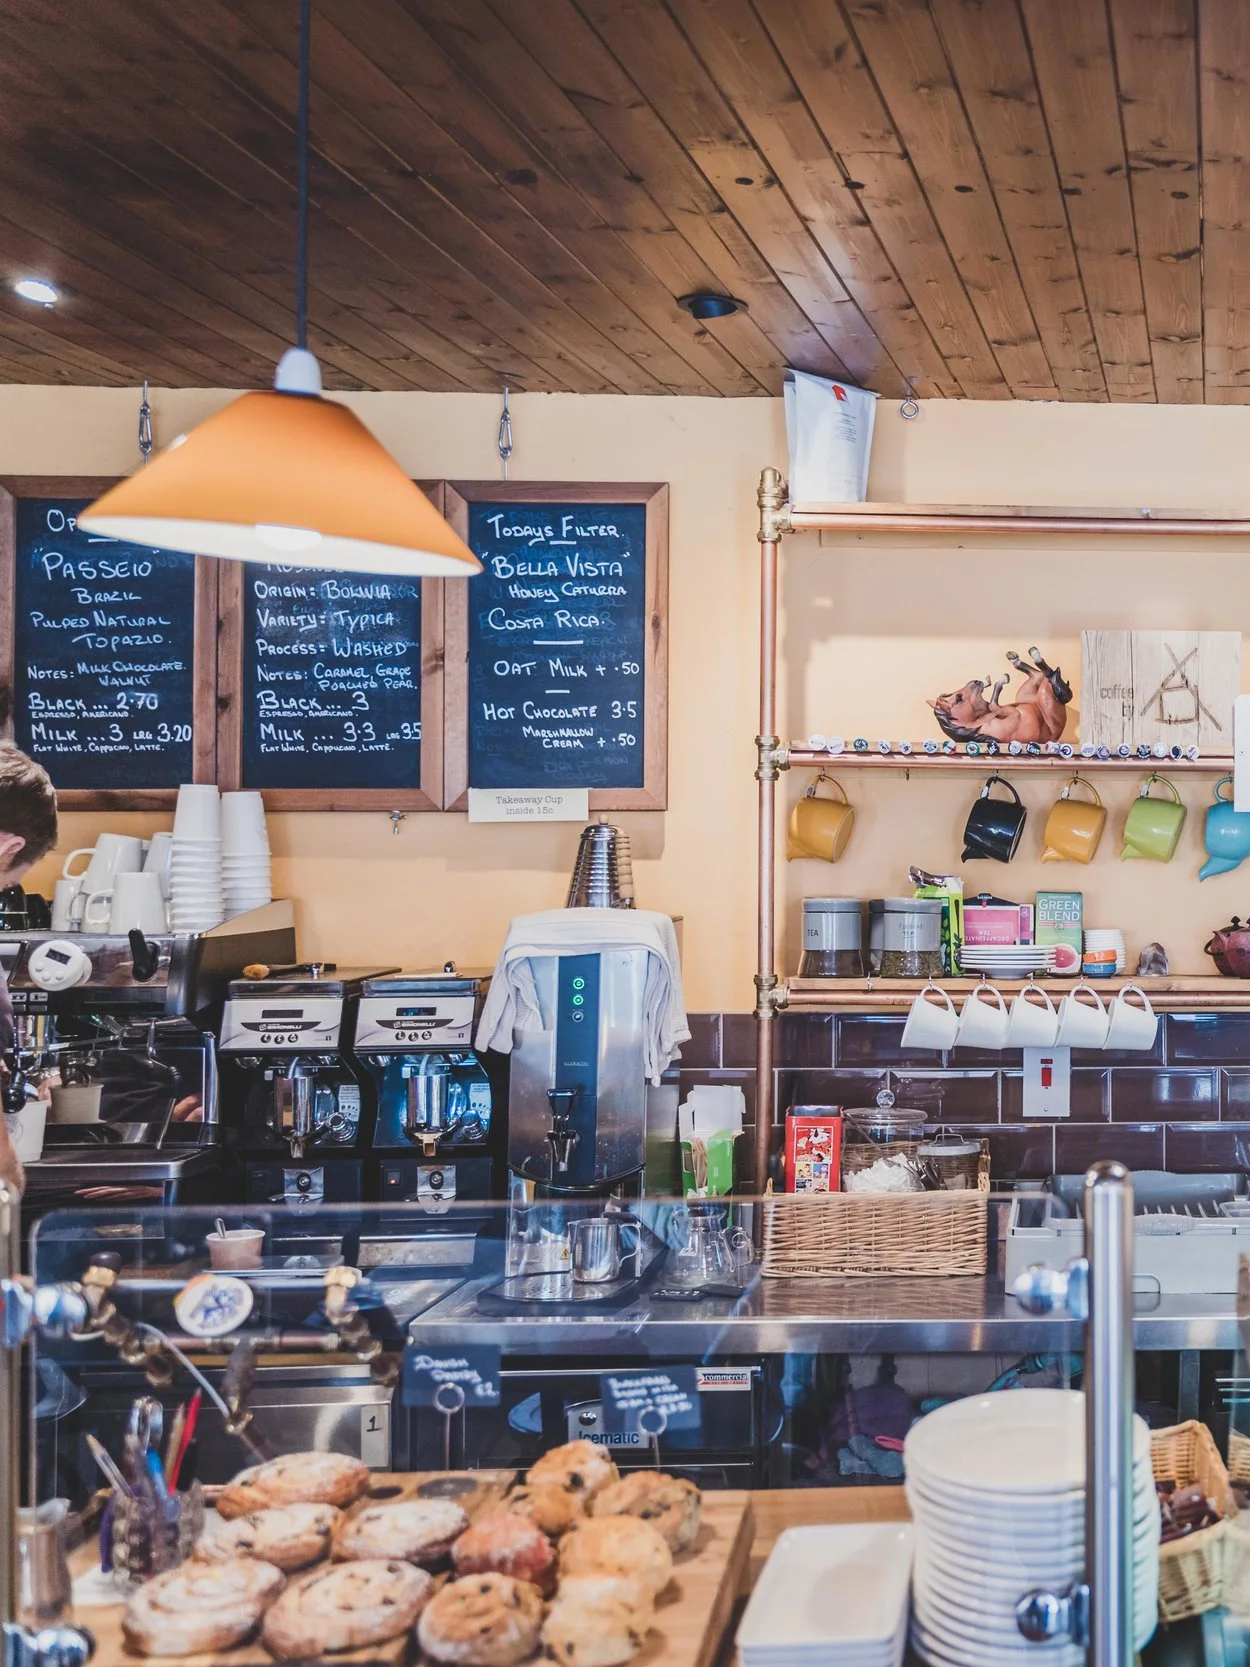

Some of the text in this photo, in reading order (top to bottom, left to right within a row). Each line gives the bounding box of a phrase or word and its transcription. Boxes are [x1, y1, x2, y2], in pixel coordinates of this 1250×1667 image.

[487, 514, 554, 546] TODAYS
[71, 588, 142, 604] BRAZIL
[509, 584, 558, 602] HONEY
[30, 610, 172, 629] PULPED NATURAL
[334, 609, 394, 633] TYPICA
[488, 607, 544, 631] COSTA
[333, 638, 407, 658] WASHED
[77, 662, 112, 675] MILK
[376, 663, 411, 677] GRAPE
[494, 661, 537, 676] OAT
[549, 658, 588, 678] MILK
[98, 674, 152, 687] WALNUT
[318, 679, 378, 691] POACHED
[1100, 684, 1133, 699] coffee
[28, 692, 87, 710] BLACK
[257, 690, 322, 710] BLACK
[352, 691, 369, 710] 3
[482, 700, 637, 720] HOT CHOCOLATE 3.5
[1122, 701, 1134, 720] by
[31, 722, 78, 741] MILK
[109, 724, 124, 742] 3
[133, 731, 153, 740] LRG
[157, 723, 192, 742] 3.20
[260, 723, 304, 741] MILK
[343, 722, 376, 742] 3.3
[522, 725, 594, 738] MARSHMALLOW
[261, 744, 280, 752] FLAT
[542, 739, 584, 749] CREAM
[496, 796, 563, 805] Takeaway Cup
[506, 806, 554, 815] inside 15c
[1039, 899, 1080, 910] GREEN
[1039, 911, 1080, 921] BLEND
[807, 929, 819, 937] TEA
[366, 1415, 382, 1432] 1
[579, 1431, 640, 1444] Icematic
